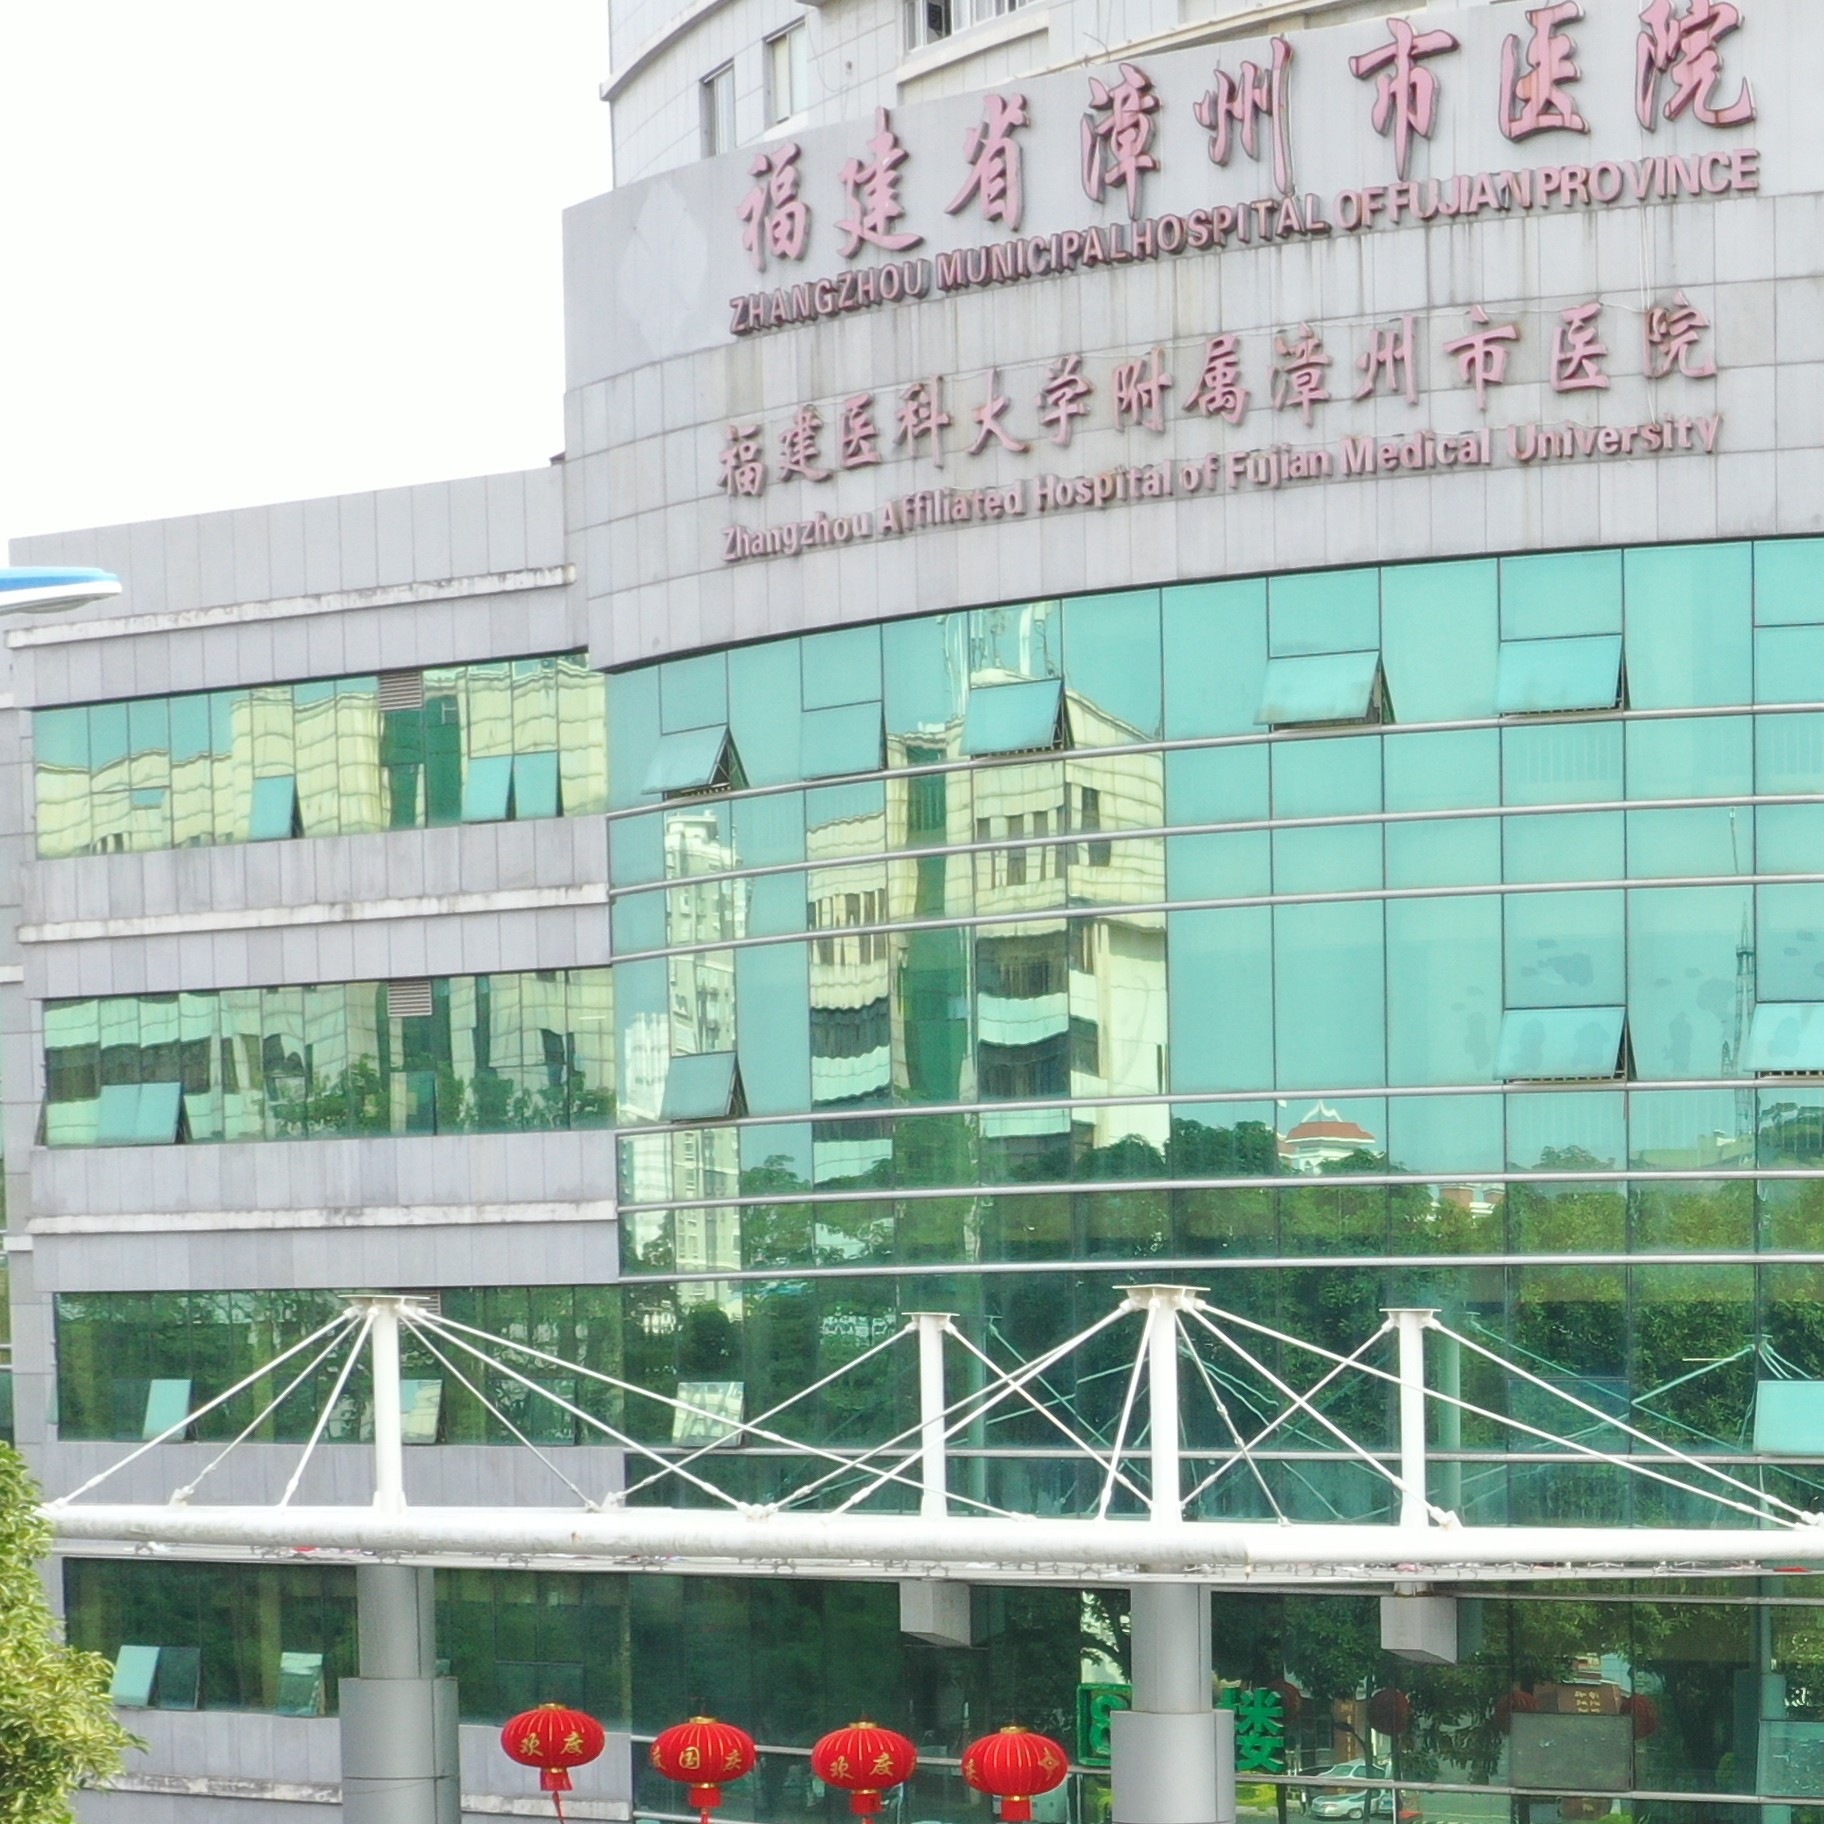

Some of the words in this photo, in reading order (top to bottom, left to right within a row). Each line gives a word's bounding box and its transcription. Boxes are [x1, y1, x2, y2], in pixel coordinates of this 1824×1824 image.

[736, 0, 1757, 272] 福建省漳州市医院
[730, 258, 930, 336] ZHANGZHOU
[719, 291, 1717, 499] 福建医科大学附属漳州市医院
[721, 511, 871, 562] Zhangzhou
[877, 482, 1025, 534] Affiliated
[1034, 459, 1173, 510] Hospital
[1181, 452, 1219, 493] of
[1226, 443, 1332, 491] Fujian
[1340, 429, 1491, 476] Medical
[1507, 412, 1722, 462] University
